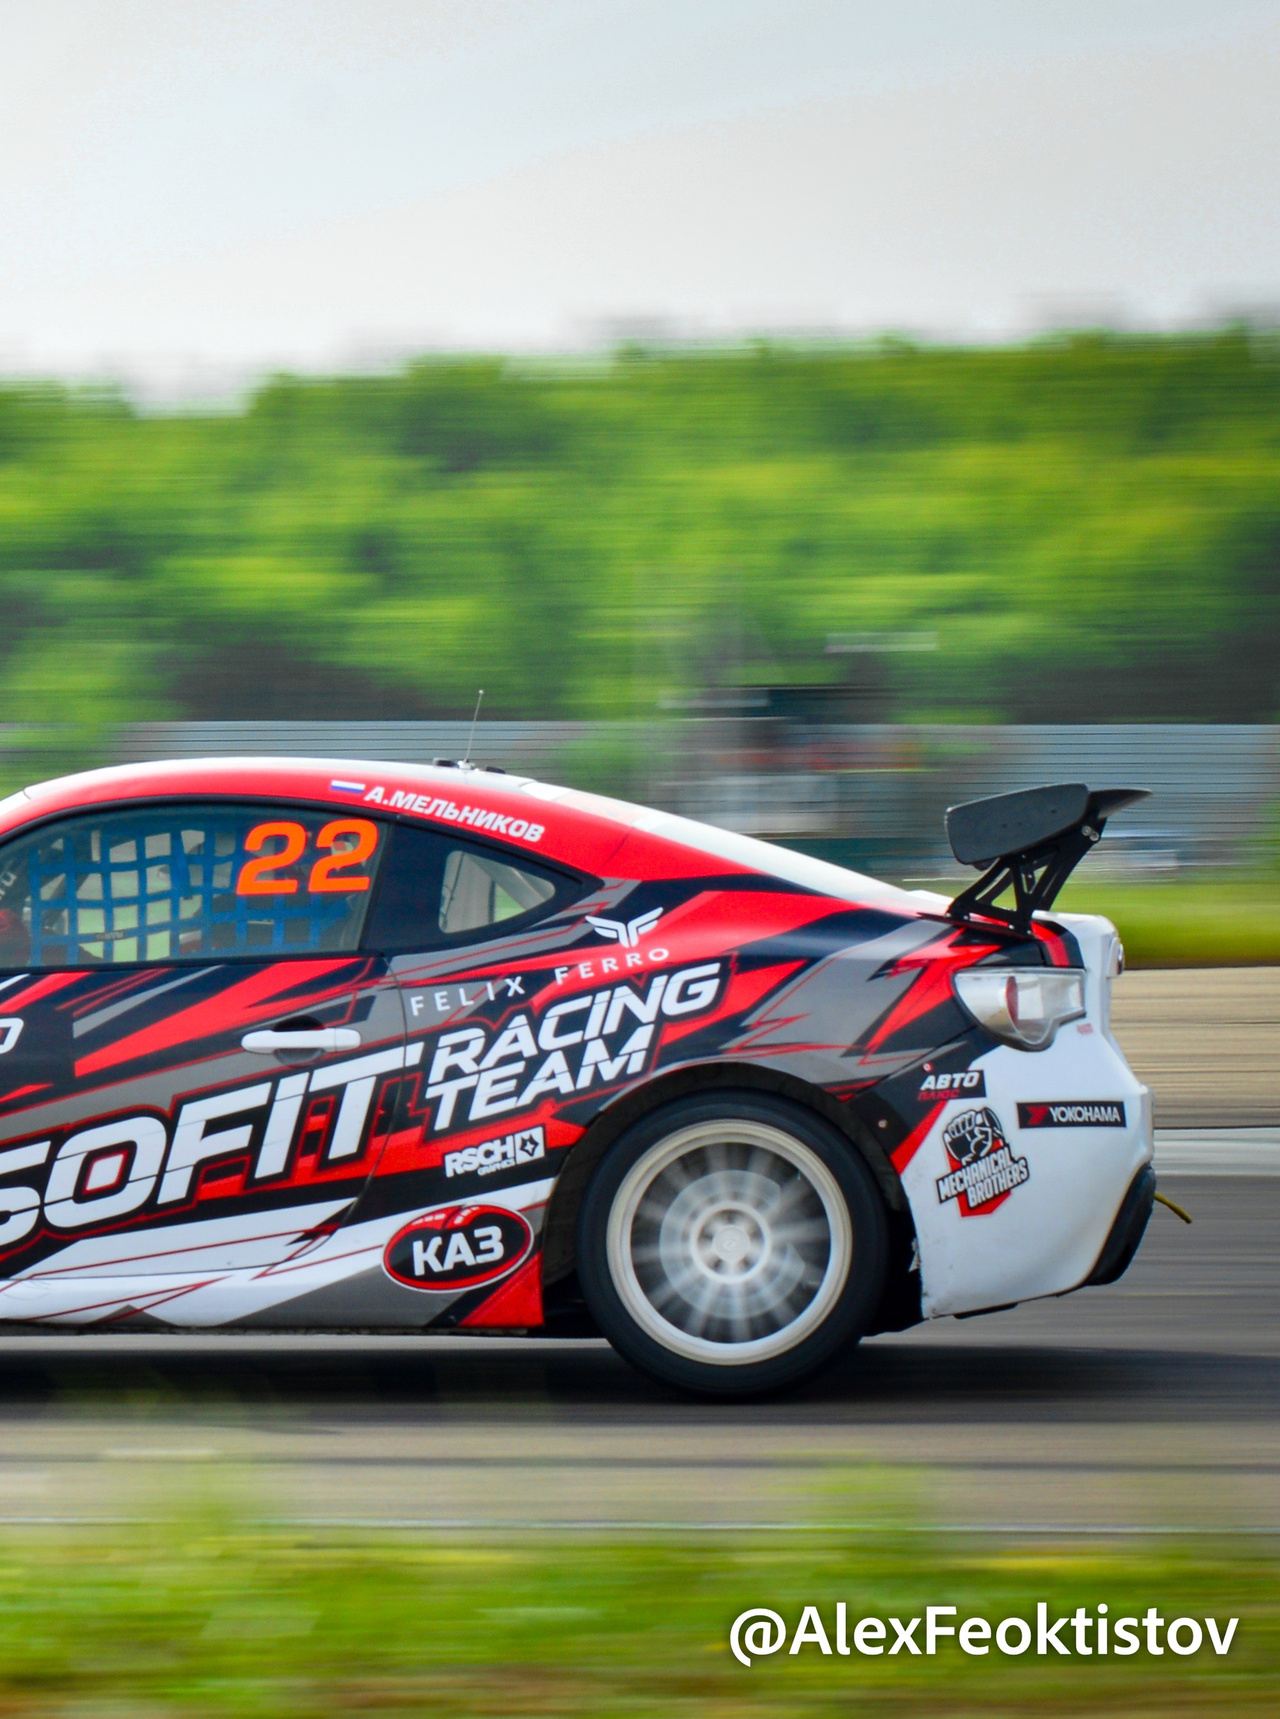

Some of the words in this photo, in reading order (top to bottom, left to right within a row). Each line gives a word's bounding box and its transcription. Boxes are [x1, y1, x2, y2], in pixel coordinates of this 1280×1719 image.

[364, 786, 545, 843] А.МЕЛЬНИКОВ
[236, 818, 378, 896] 22
[411, 976, 526, 1016] FELIX
[554, 947, 669, 985] FERRO
[428, 962, 721, 1085] RACING
[425, 1023, 655, 1131] TEAM
[920, 1071, 980, 1091] АВТО
[1049, 1105, 1121, 1123] YOKOHAMA
[444, 1134, 516, 1178] RSCH
[938, 1146, 1013, 1202] MECHANICAL
[967, 1158, 1029, 1208] BROTHERS
